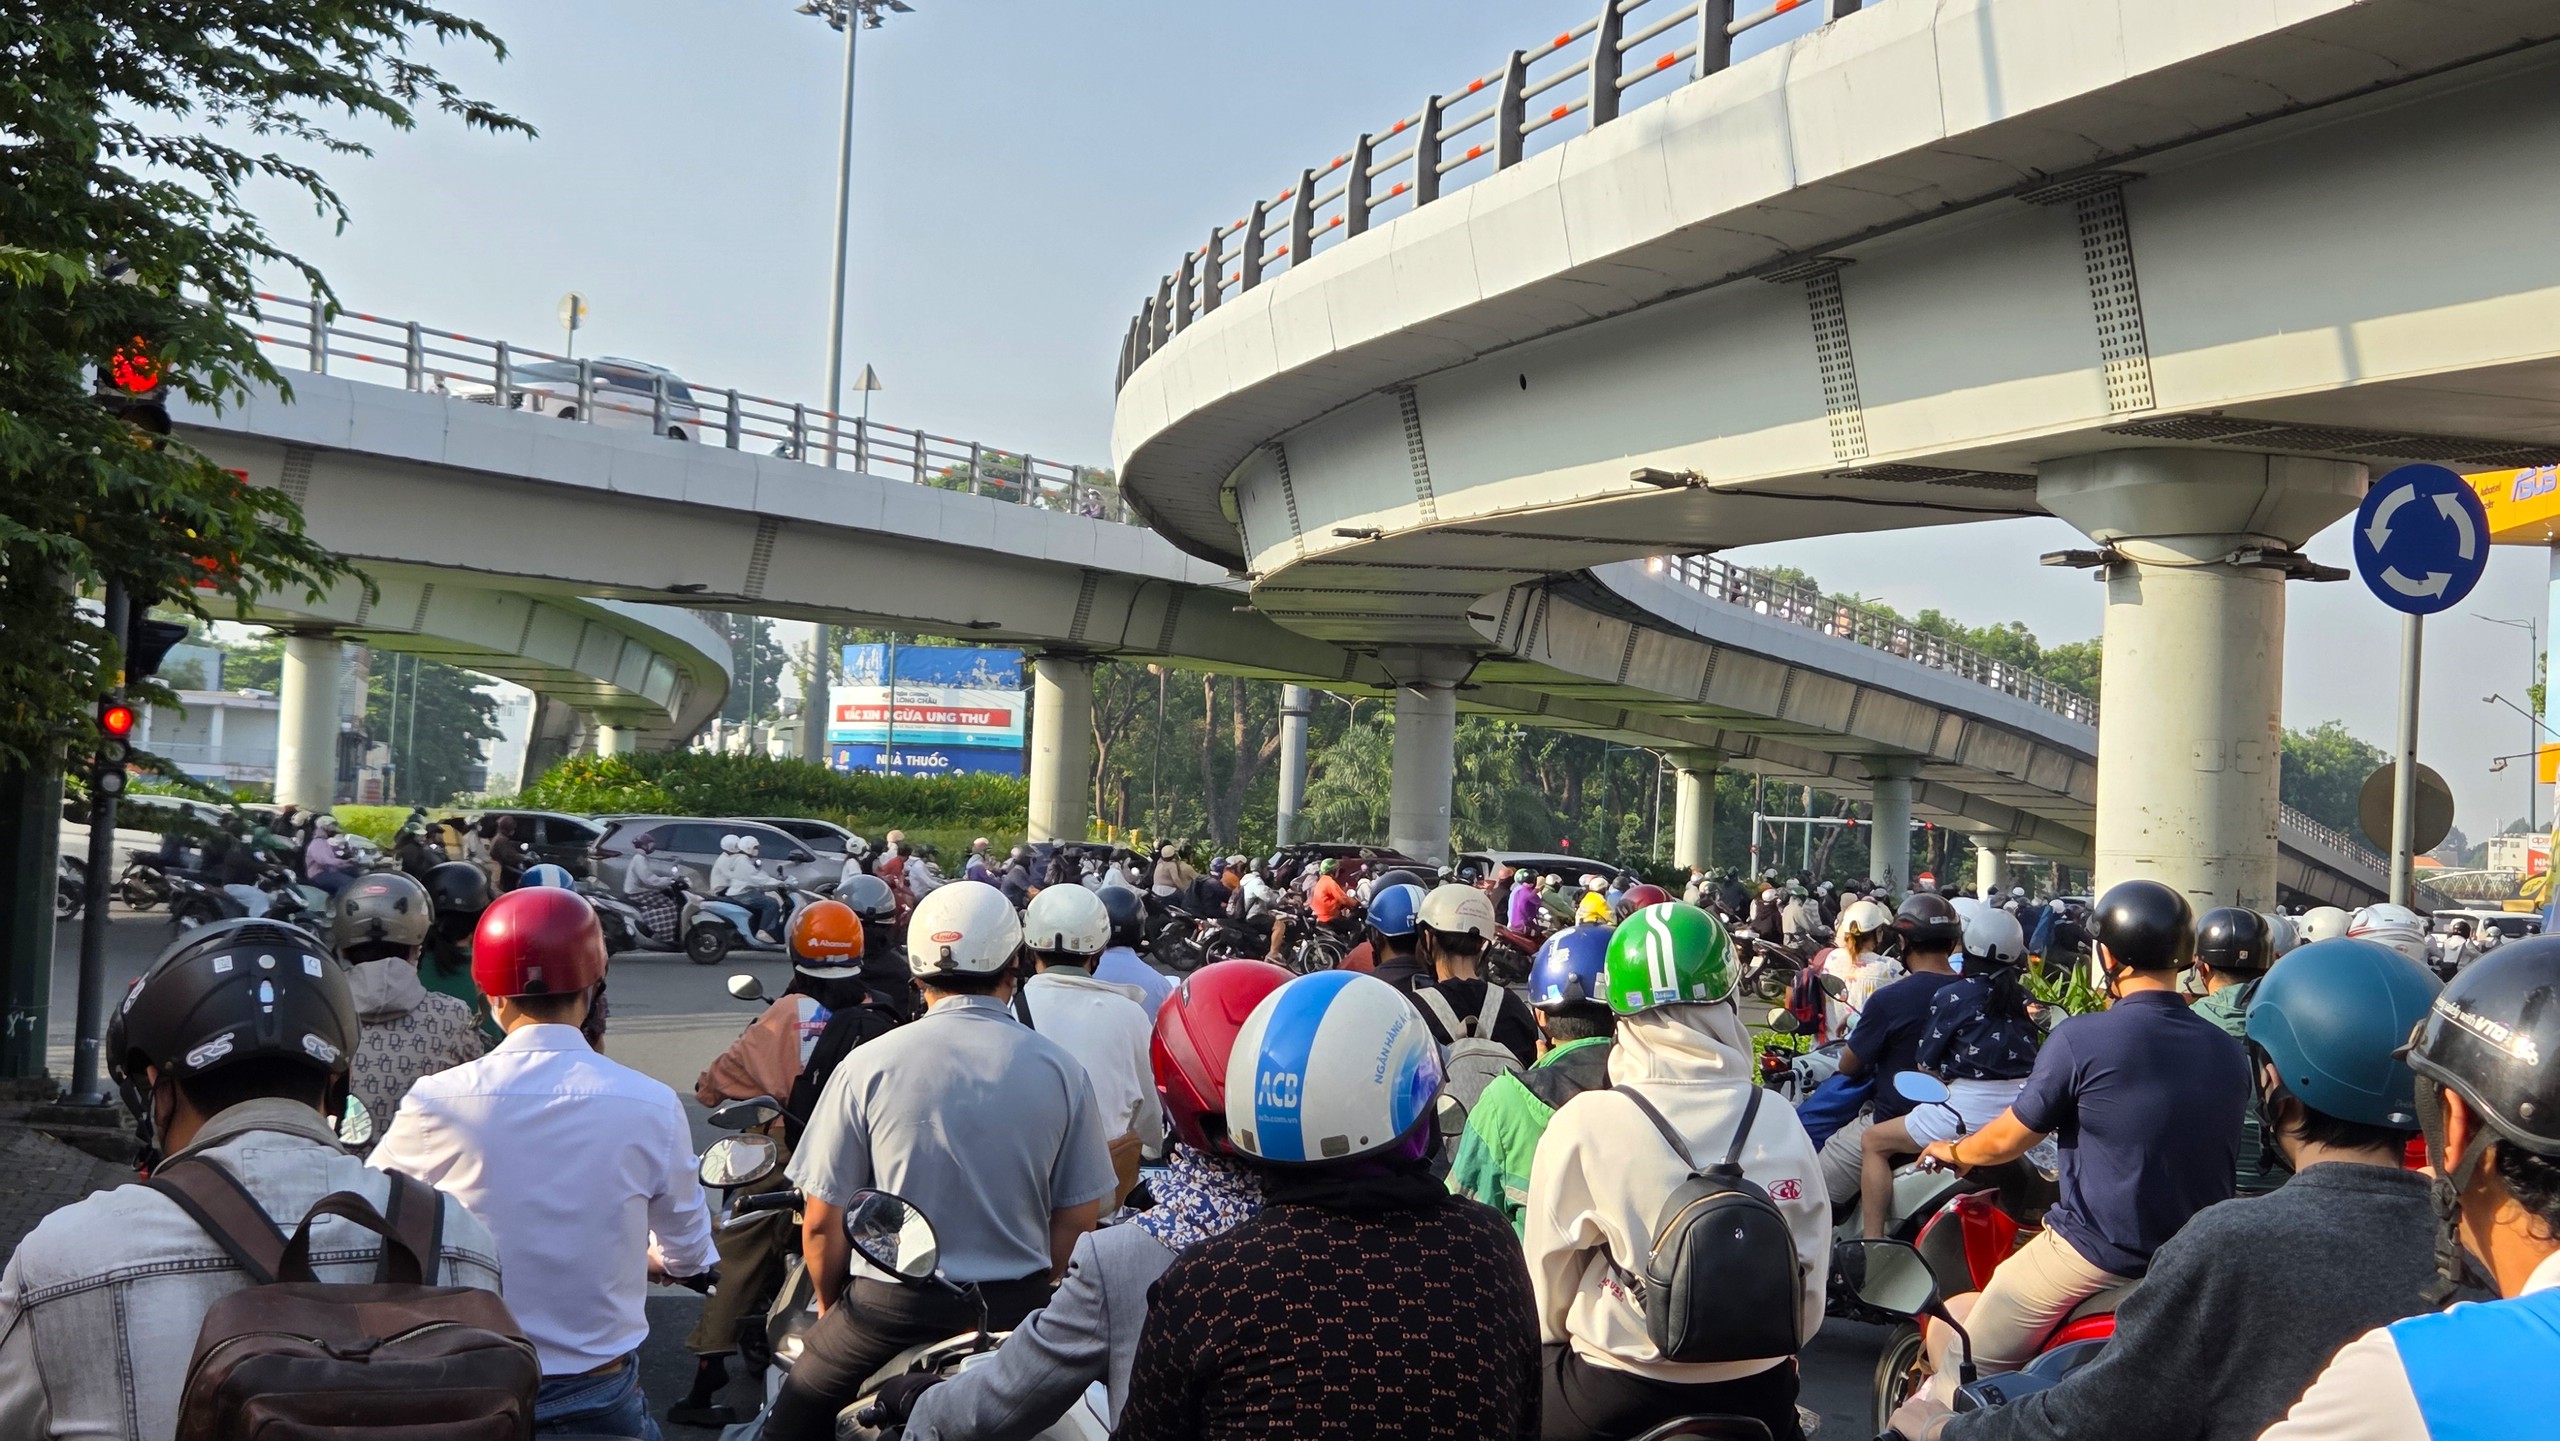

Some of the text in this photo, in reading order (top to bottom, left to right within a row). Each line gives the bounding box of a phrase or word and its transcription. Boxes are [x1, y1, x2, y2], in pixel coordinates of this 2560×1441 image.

[862, 709, 881, 721] XIN
[926, 711, 957, 723] UNG
[959, 711, 990, 725] THƯ
[906, 751, 949, 767] THUỐC
[1374, 1049, 1392, 1085] NGÂN
[1384, 1019, 1404, 1048] HÀNG
[1258, 1071, 1299, 1108] ACB
[1258, 1115, 1298, 1124] acb.com.vn
[1355, 1224, 1384, 1232] D&G
[1235, 1237, 1261, 1248] D&G
[1389, 1235, 1417, 1243] D&G
[1448, 1234, 1472, 1242] D&G
[1267, 1241, 1296, 1251] D&G
[1185, 1256, 1206, 1271] D&G
[1213, 1257, 1236, 1271] D&G
[1244, 1260, 1269, 1272] D&G
[1276, 1270, 1304, 1279] D&G
[1451, 1266, 1474, 1274] D&G
[1195, 1282, 1216, 1298] D&G
[1224, 1283, 1247, 1297] D&G
[1253, 1290, 1279, 1301] D&G
[1286, 1302, 1312, 1310] D&G
[1453, 1300, 1476, 1308] D&G
[1235, 1314, 1257, 1327] D&G
[1264, 1323, 1288, 1333] D&G
[1294, 1335, 1319, 1344] D&G
[1456, 1335, 1477, 1345] D&G
[1431, 1351, 1455, 1359] D&G
[1297, 1368, 1322, 1377] D&G
[1405, 1368, 1430, 1376] D&G
[1247, 1375, 1270, 1383] D&G
[1457, 1373, 1479, 1383] D&G
[1272, 1386, 1295, 1394] D&G
[1432, 1388, 1456, 1397] D&G
[1405, 1405, 1430, 1413] D&G
[1457, 1411, 1478, 1421] D&G
[1431, 1426, 1454, 1435] D&G
